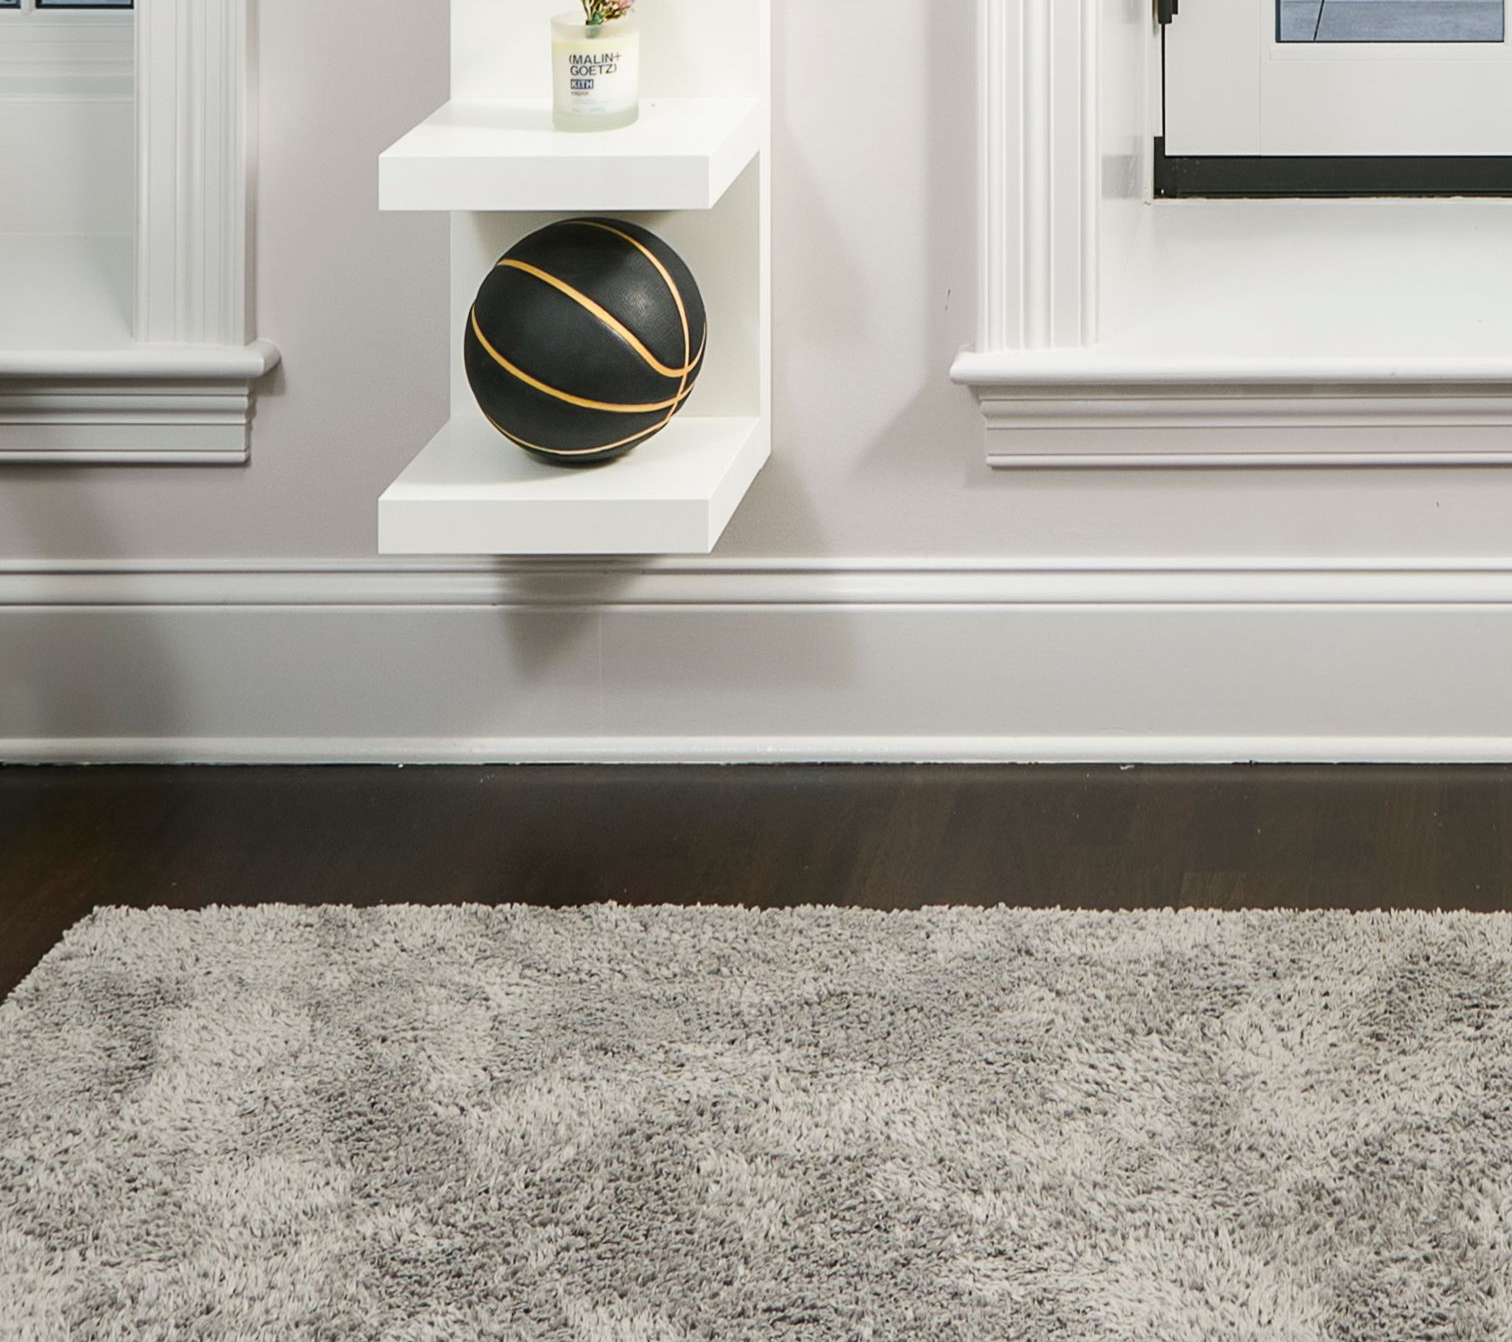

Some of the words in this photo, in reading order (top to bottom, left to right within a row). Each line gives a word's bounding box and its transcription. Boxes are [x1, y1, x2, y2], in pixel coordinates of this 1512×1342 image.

[569, 52, 621, 65] (MALIN+
[570, 63, 617, 76] GOETZ)
[571, 80, 593, 89] KITH
